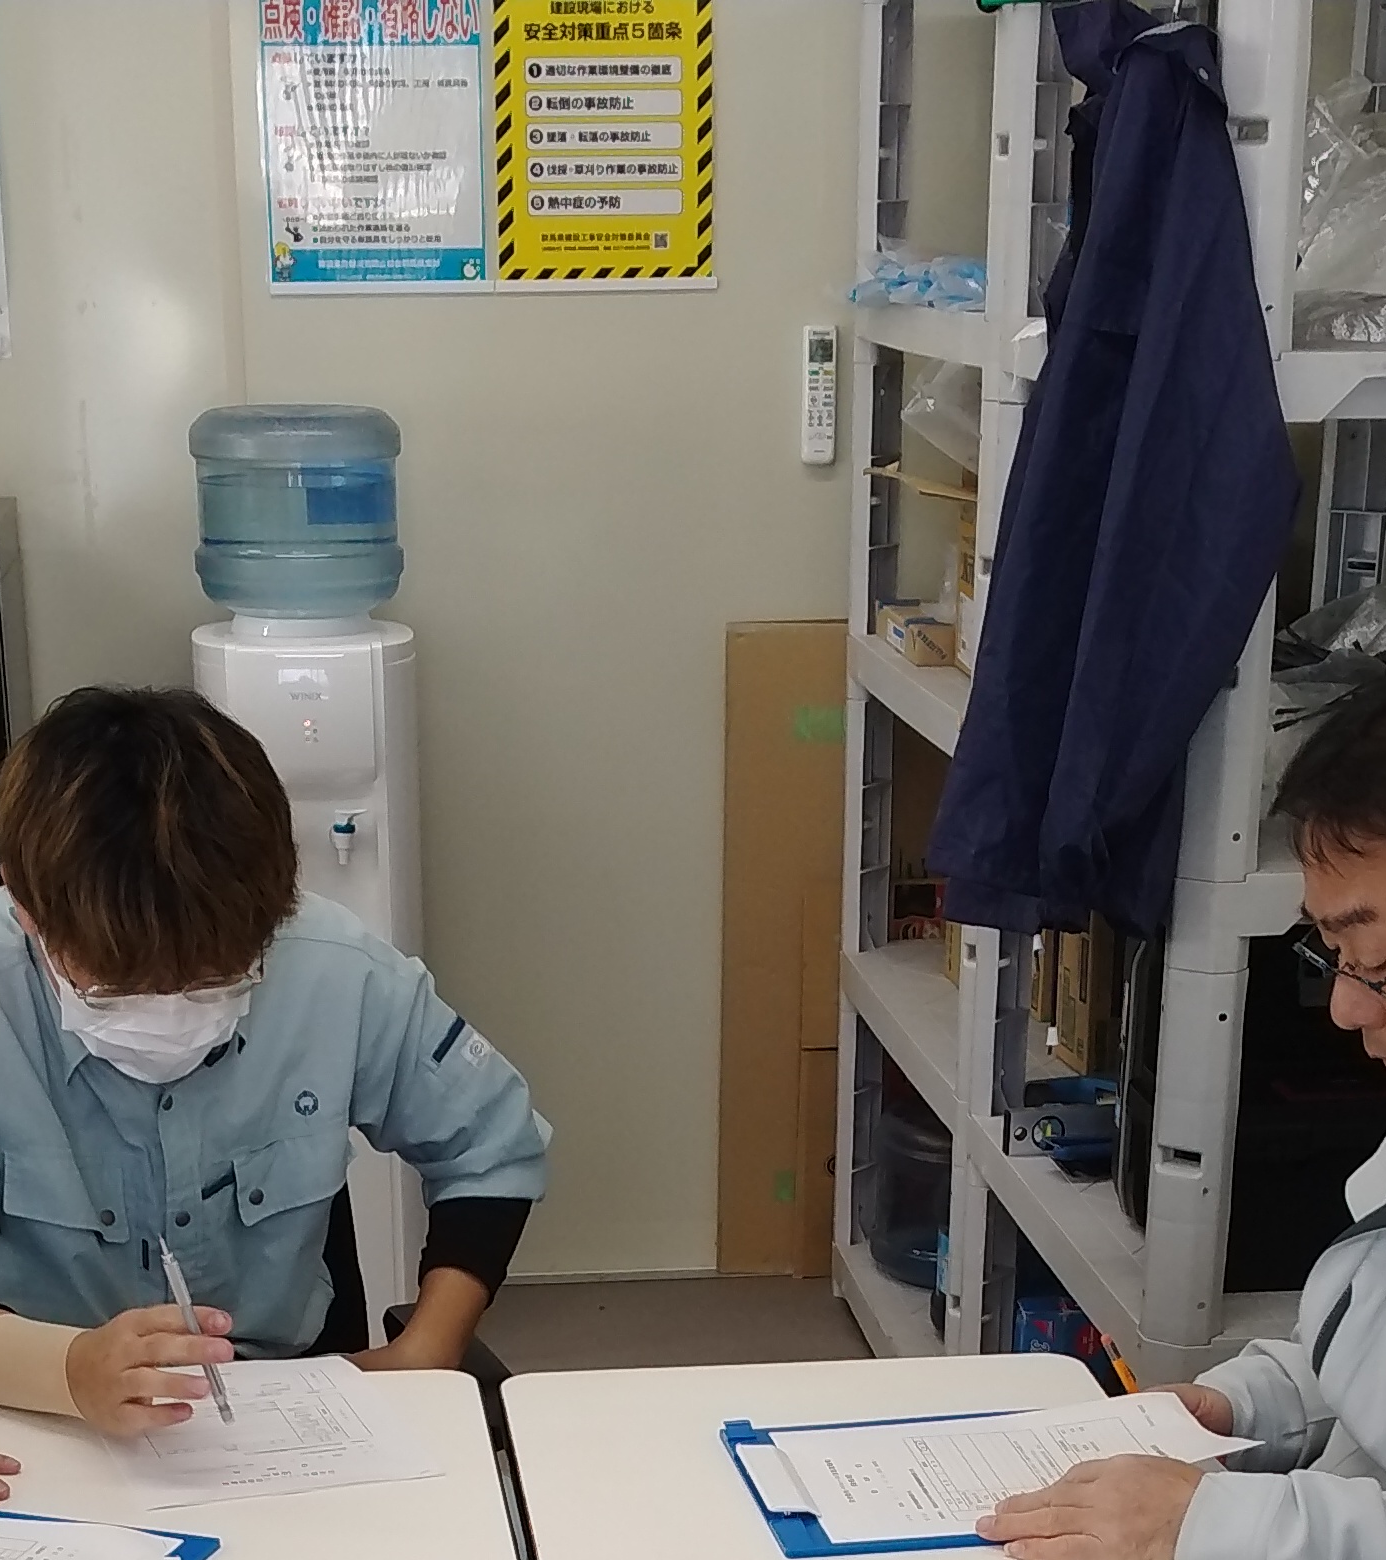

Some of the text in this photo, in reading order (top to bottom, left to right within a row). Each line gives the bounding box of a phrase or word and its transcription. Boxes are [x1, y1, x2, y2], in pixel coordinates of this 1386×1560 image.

[550, 1, 655, 15] 建設現場における
[524, 22, 682, 41] 安全対策重点5箇条
[546, 96, 634, 110] 転倒の事故防止
[547, 196, 621, 209] 熱中症の予防
